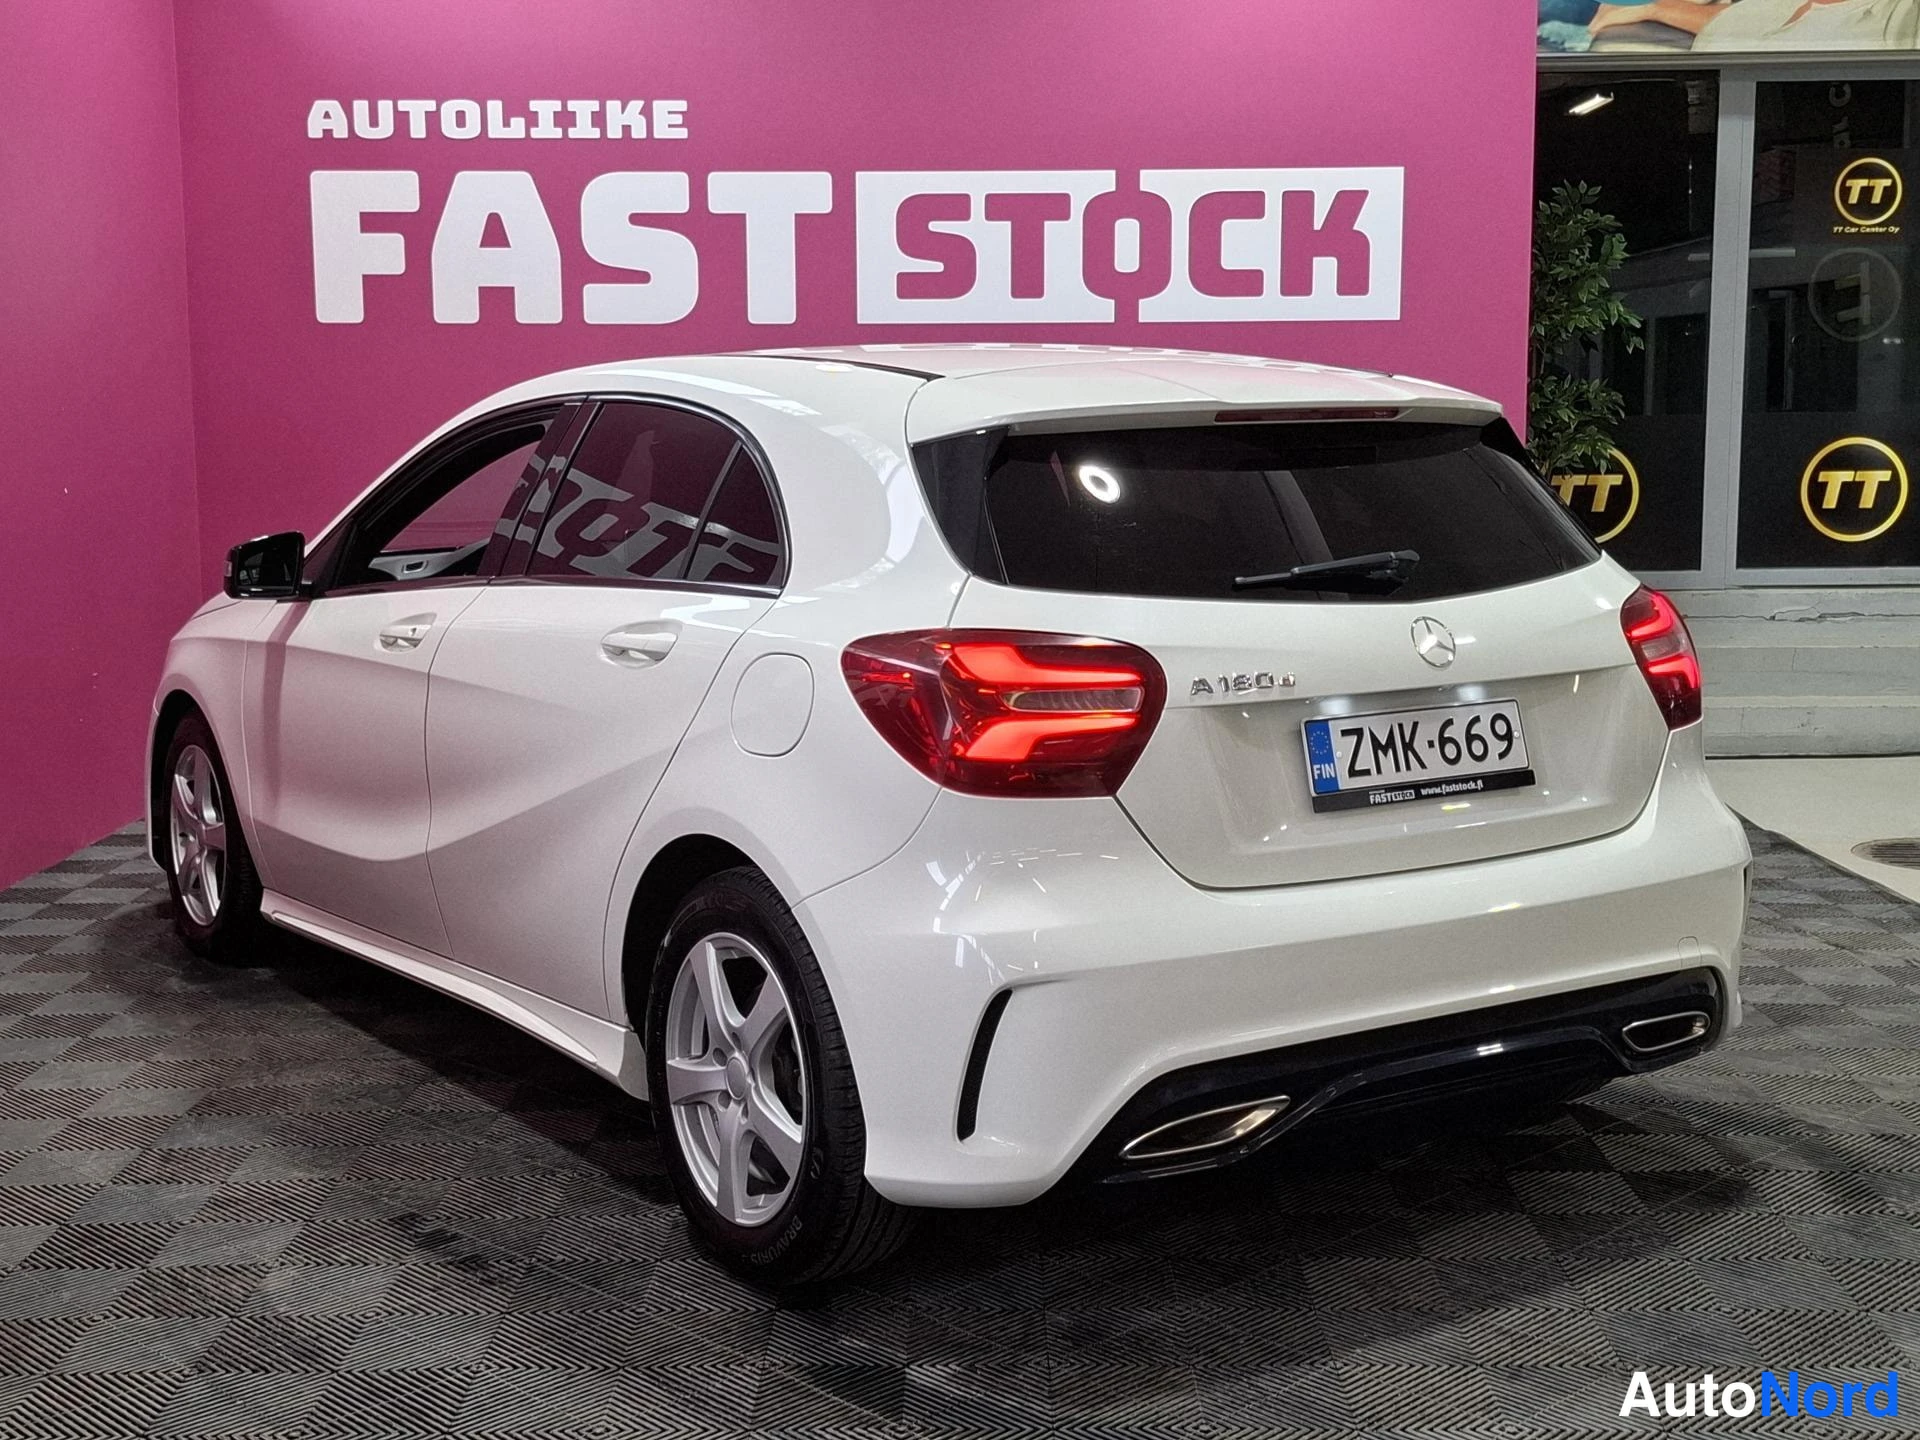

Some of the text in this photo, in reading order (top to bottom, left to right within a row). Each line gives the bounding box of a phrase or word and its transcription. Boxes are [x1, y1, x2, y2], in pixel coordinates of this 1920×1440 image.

[307, 99, 689, 139] AUTOLIIKE
[1845, 178, 1893, 205] TT
[309, 170, 1371, 325] FAST STOCK
[1550, 474, 1624, 513] TT
[1817, 470, 1892, 510] TT
[1340, 712, 1514, 779] ZMK-669
[1313, 763, 1336, 780] FIN
